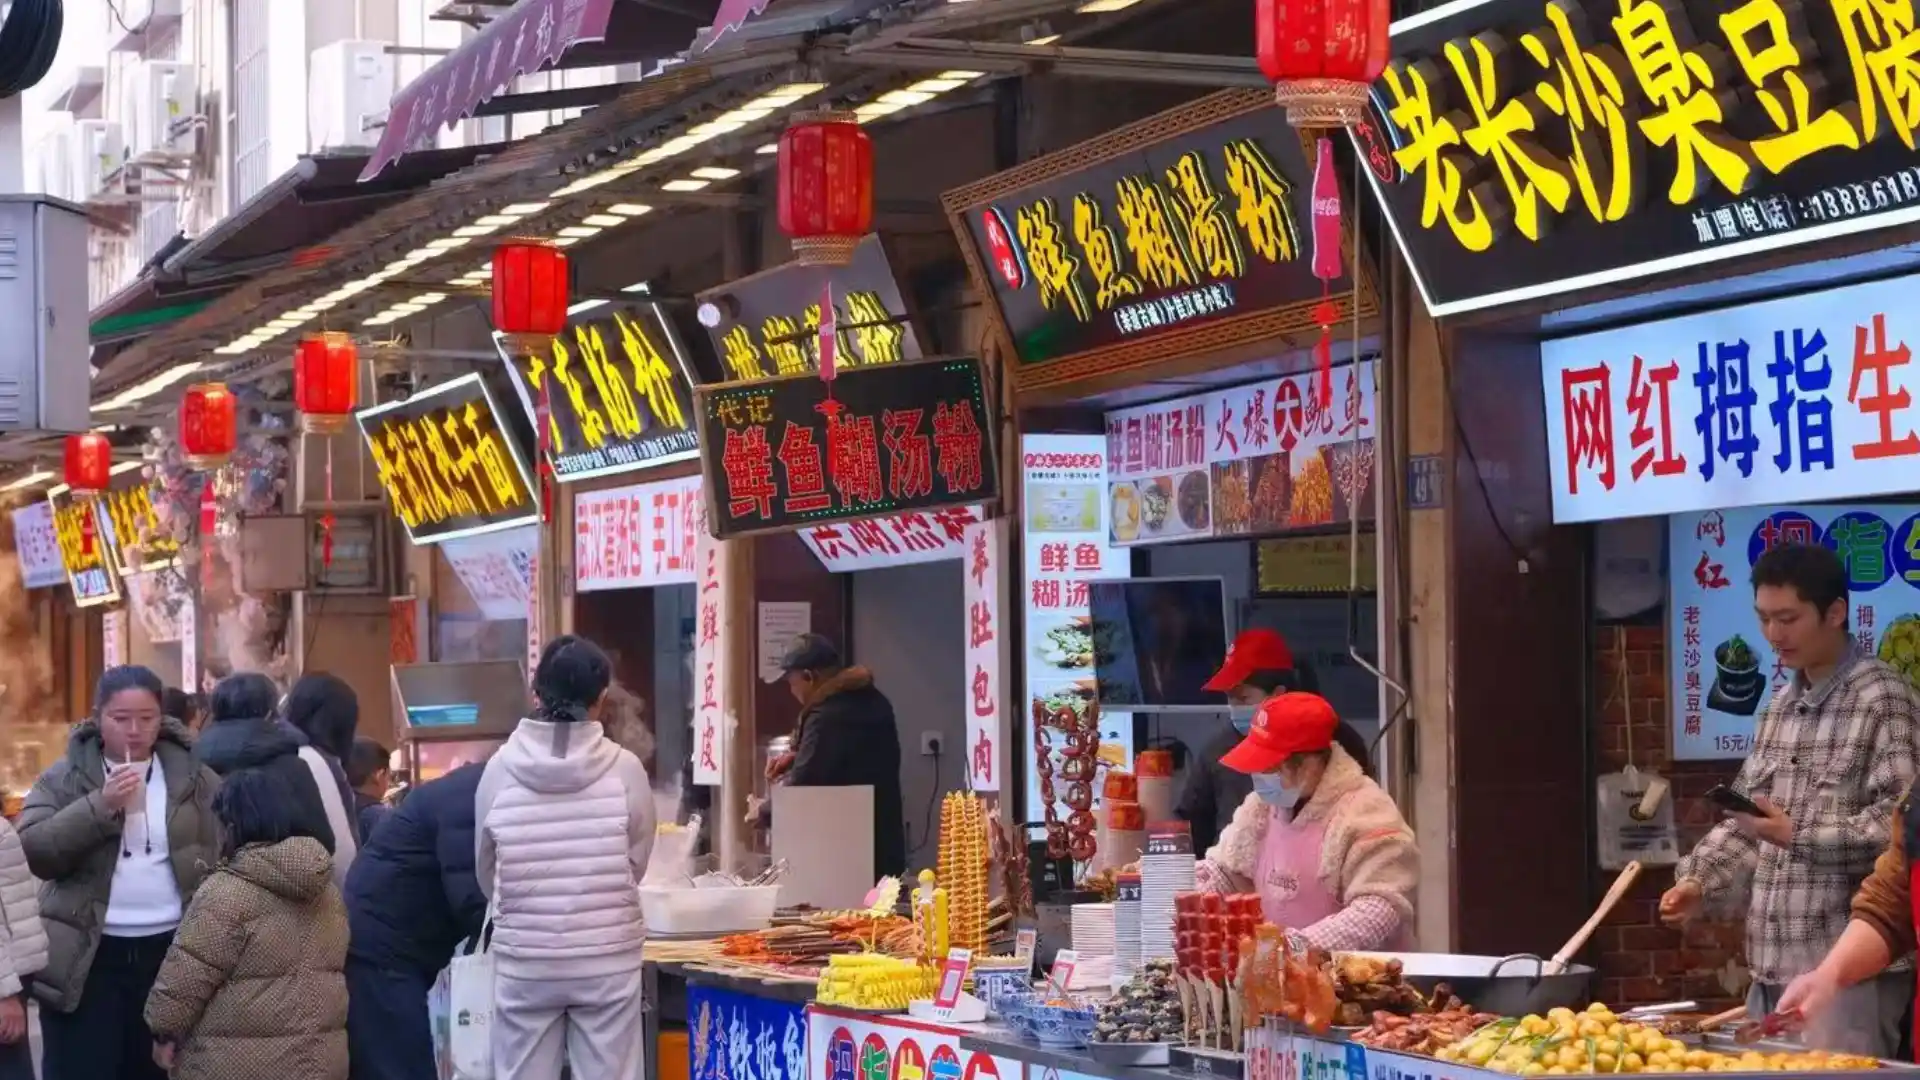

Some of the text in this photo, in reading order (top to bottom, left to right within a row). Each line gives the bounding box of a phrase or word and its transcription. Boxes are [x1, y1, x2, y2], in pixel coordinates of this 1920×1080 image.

[717, 395, 773, 425] 代记
[1107, 403, 1205, 476] 鲜鱼糊汤粉
[1560, 313, 1920, 495] 网红拇指生
[722, 400, 983, 520] 鲜鱼糊汤粉
[1040, 543, 1102, 572] 鲜鱼
[1694, 510, 1731, 590] 网红
[1032, 579, 1091, 609] 糊汤
[970, 528, 995, 785] 羊肚包肉
[1683, 605, 1702, 737] 老长沙臭豆腐
